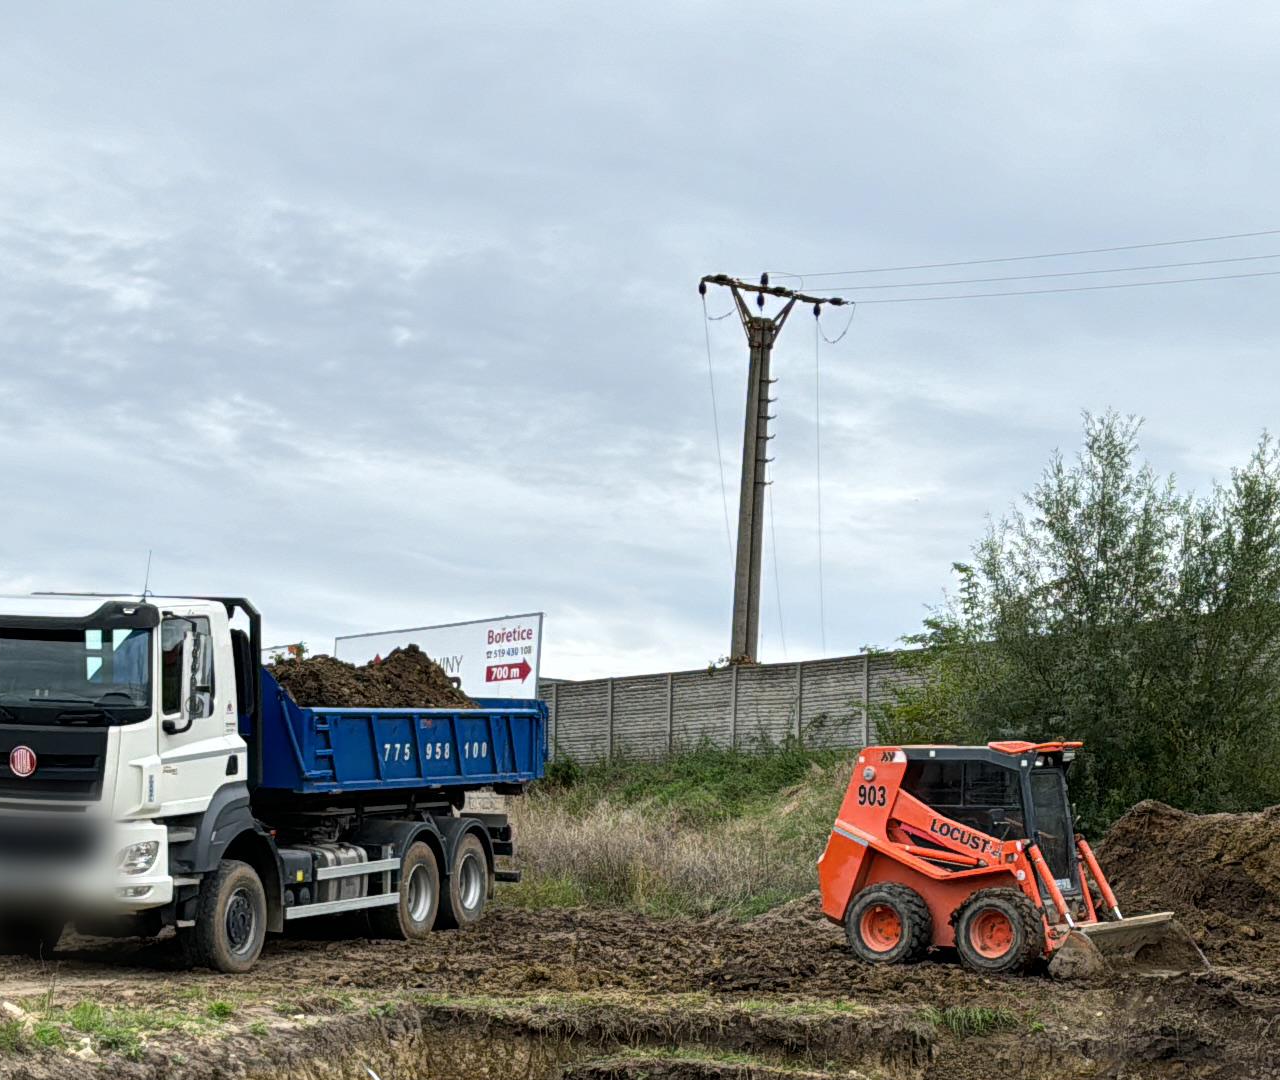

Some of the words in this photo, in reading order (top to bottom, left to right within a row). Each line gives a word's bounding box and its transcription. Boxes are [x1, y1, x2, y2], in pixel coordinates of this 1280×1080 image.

[488, 625, 532, 644] Bořetice
[491, 667, 508, 680] 700
[511, 668, 519, 678] m
[384, 744, 410, 761] 775
[426, 743, 449, 759] 958
[465, 742, 487, 758] 100
[858, 784, 886, 806] 903
[930, 819, 990, 853] LOCUST
